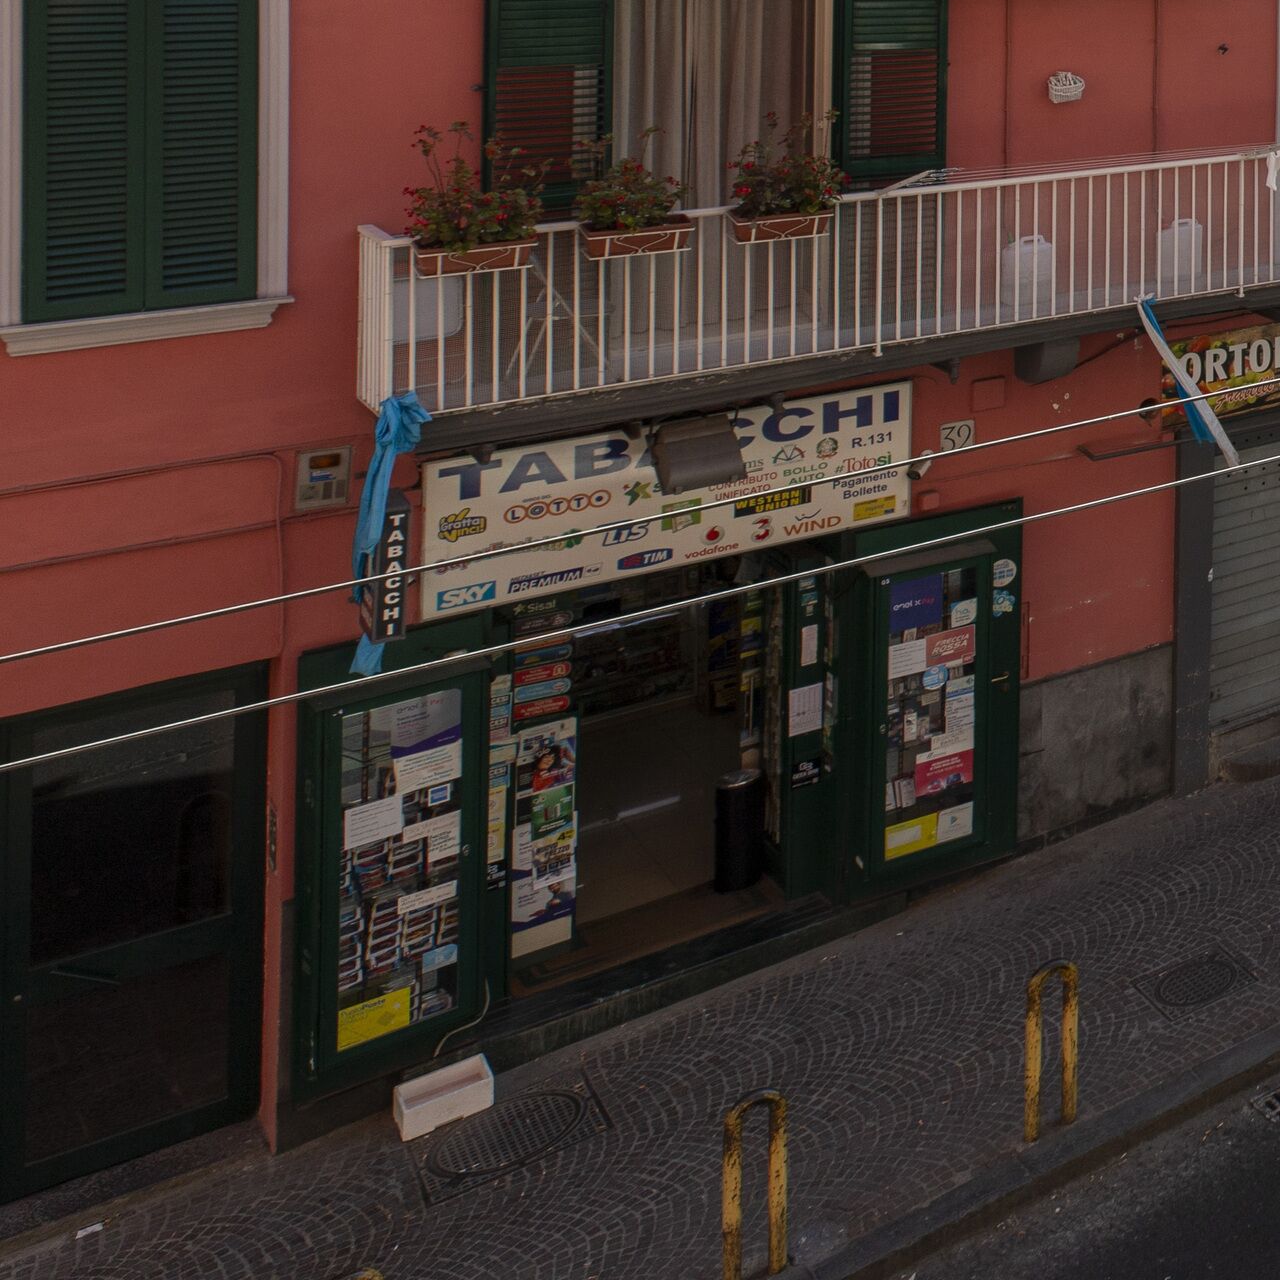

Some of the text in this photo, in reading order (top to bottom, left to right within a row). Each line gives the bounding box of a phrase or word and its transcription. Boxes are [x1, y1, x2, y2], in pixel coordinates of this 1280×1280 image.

[851, 431, 893, 449] R.131
[782, 462, 829, 477] BOLLO
[788, 472, 825, 486] AUTO
[832, 470, 898, 490] Pagamento
[715, 484, 771, 501] UNIFICATO
[735, 489, 801, 511] WESTERN
[843, 484, 888, 500] Bollette
[755, 497, 801, 513] UNION
[440, 518, 480, 532] Gratta
[783, 516, 842, 537] WIND
[643, 549, 668, 565] TIM
[685, 543, 739, 560] vodafone
[382, 513, 405, 636] TABACCHI
[510, 570, 583, 594] PREMIUM
[439, 582, 495, 609] SKY
[931, 640, 968, 656] ROSSA
